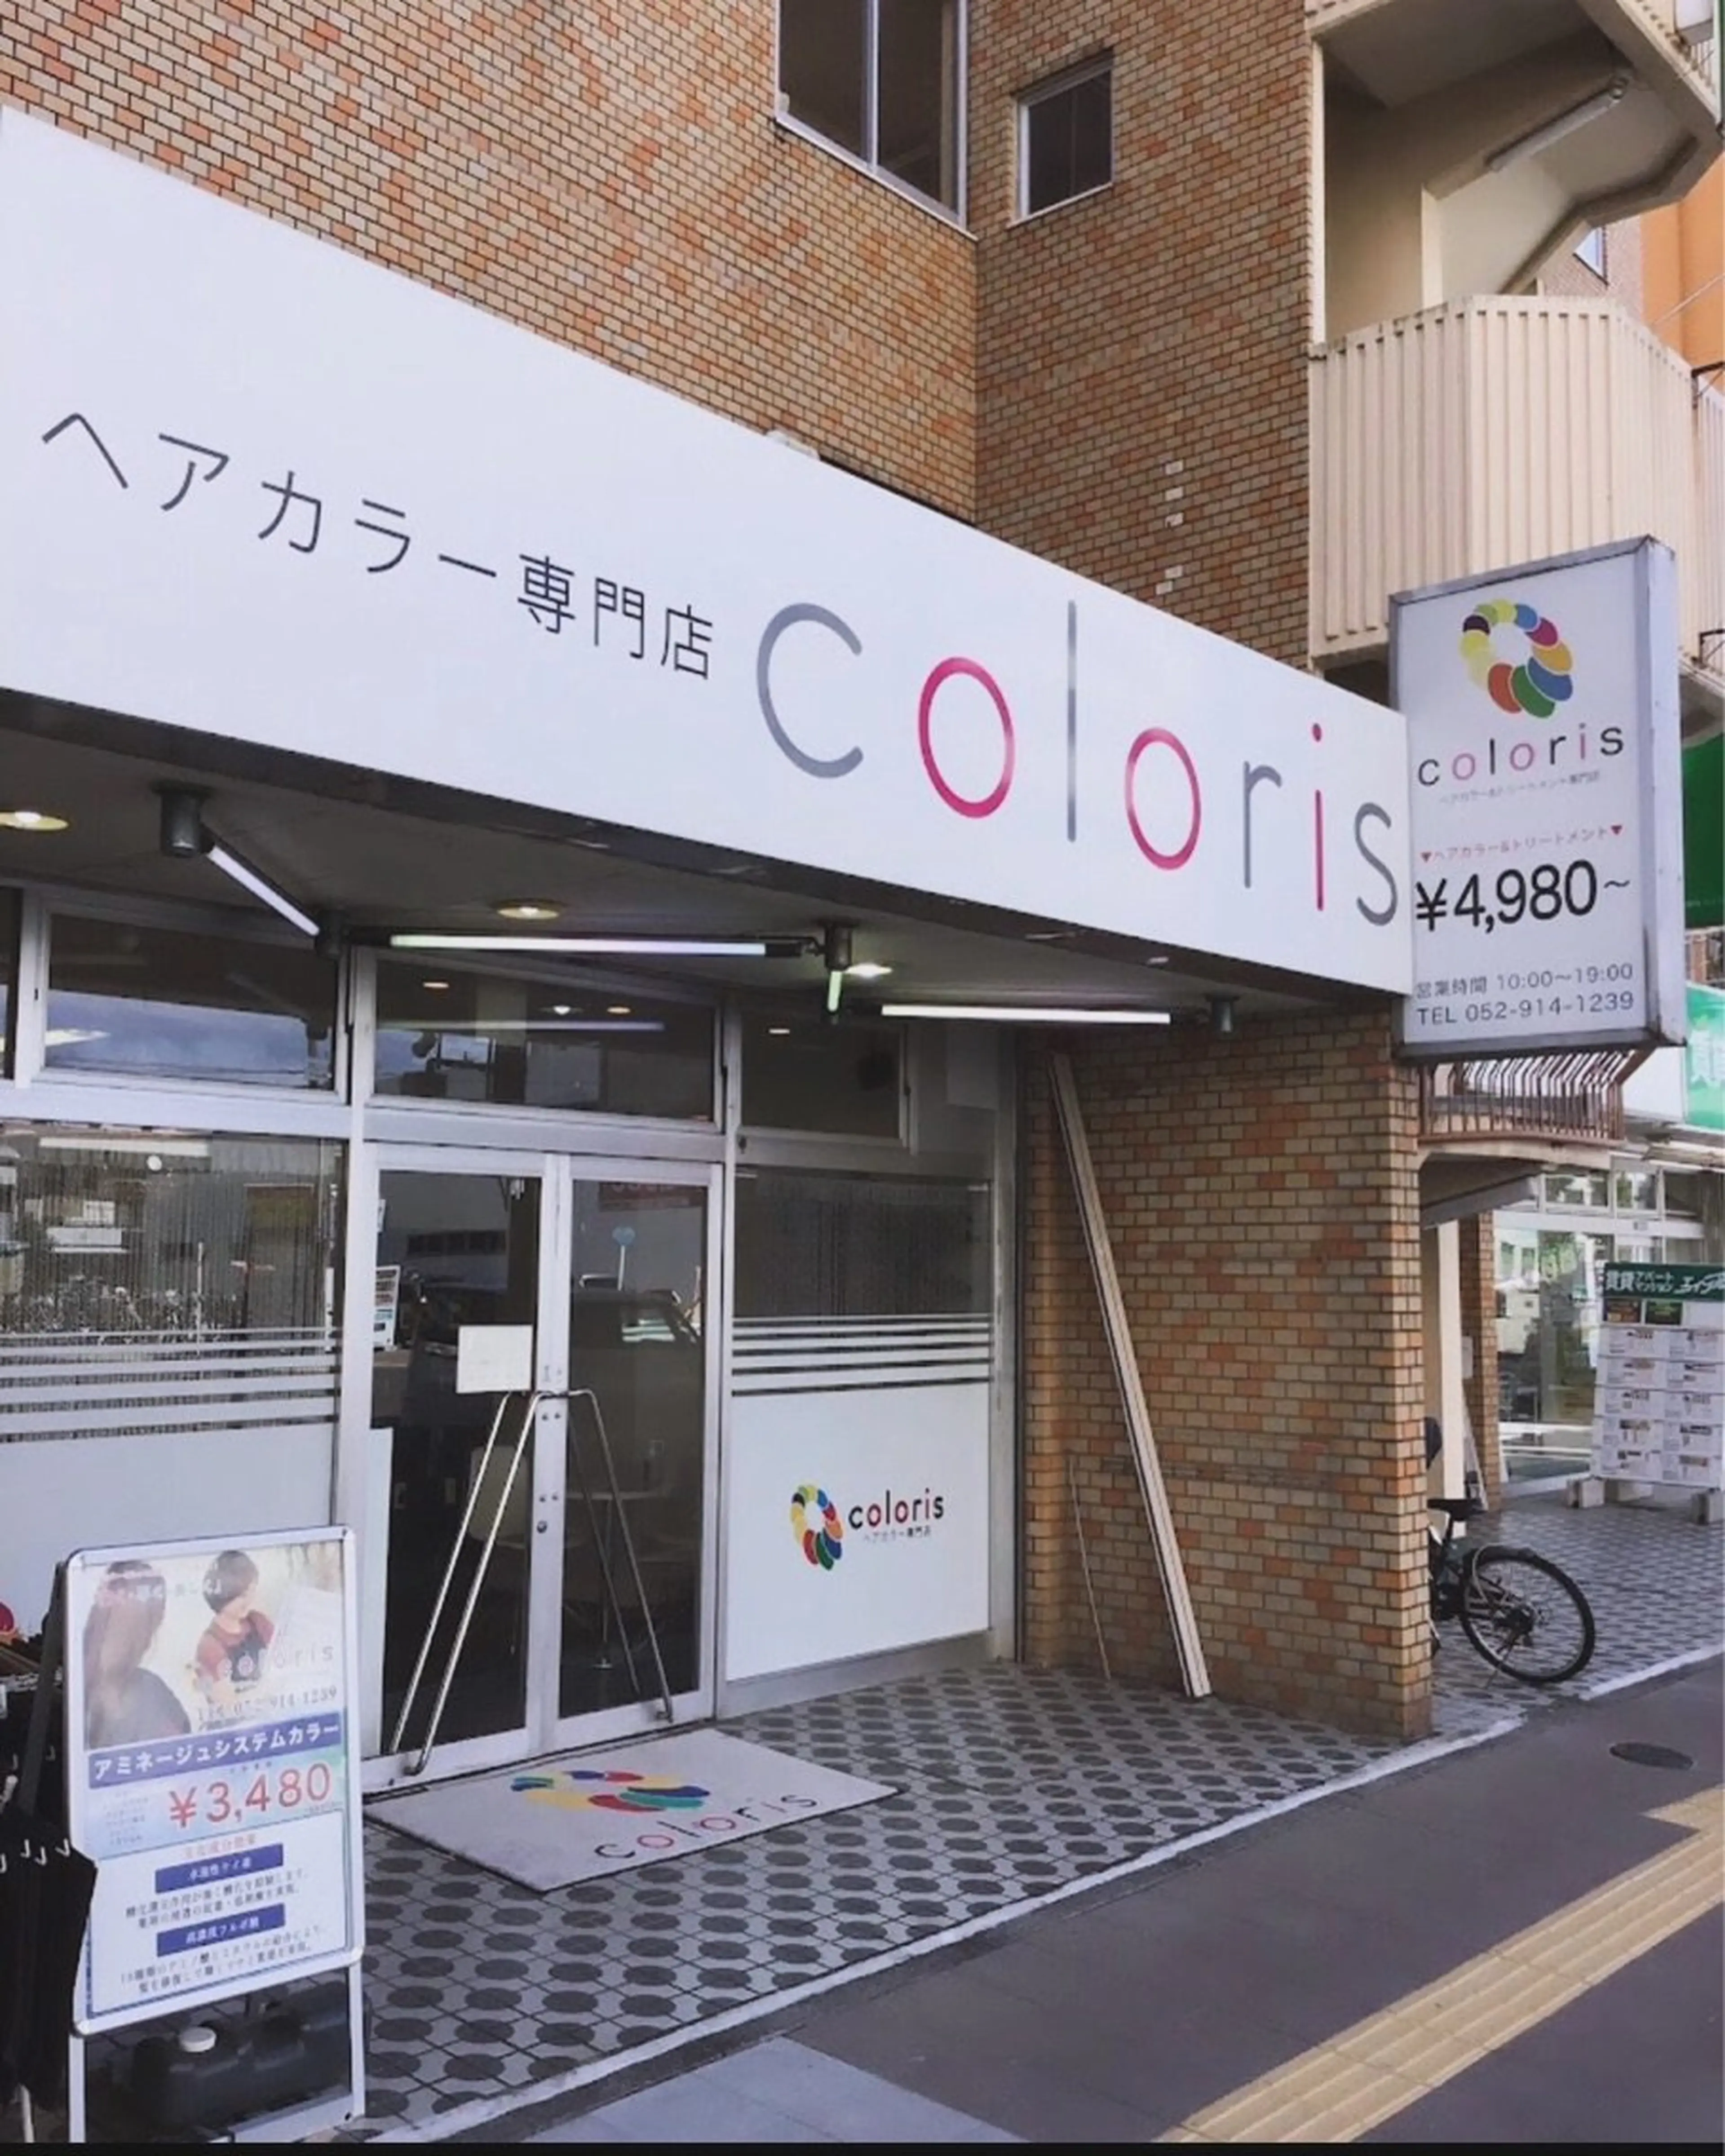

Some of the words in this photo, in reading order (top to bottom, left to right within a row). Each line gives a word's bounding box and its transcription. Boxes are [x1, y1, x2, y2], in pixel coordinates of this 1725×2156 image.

[41, 412, 714, 680] ヘアカラー専門店
[757, 600, 1399, 927] coloris
[1418, 723, 1624, 786] coloris
[1415, 976, 1487, 999] 営業時間
[1416, 1007, 1457, 1025] TEL
[1465, 991, 1634, 1022] 052-914-1239
[848, 1487, 944, 1530] coloris
[94, 1719, 339, 1782] アミネージュシステムカラー
[168, 1761, 332, 1829] ¥3,480
[594, 1794, 818, 1860] coloris
